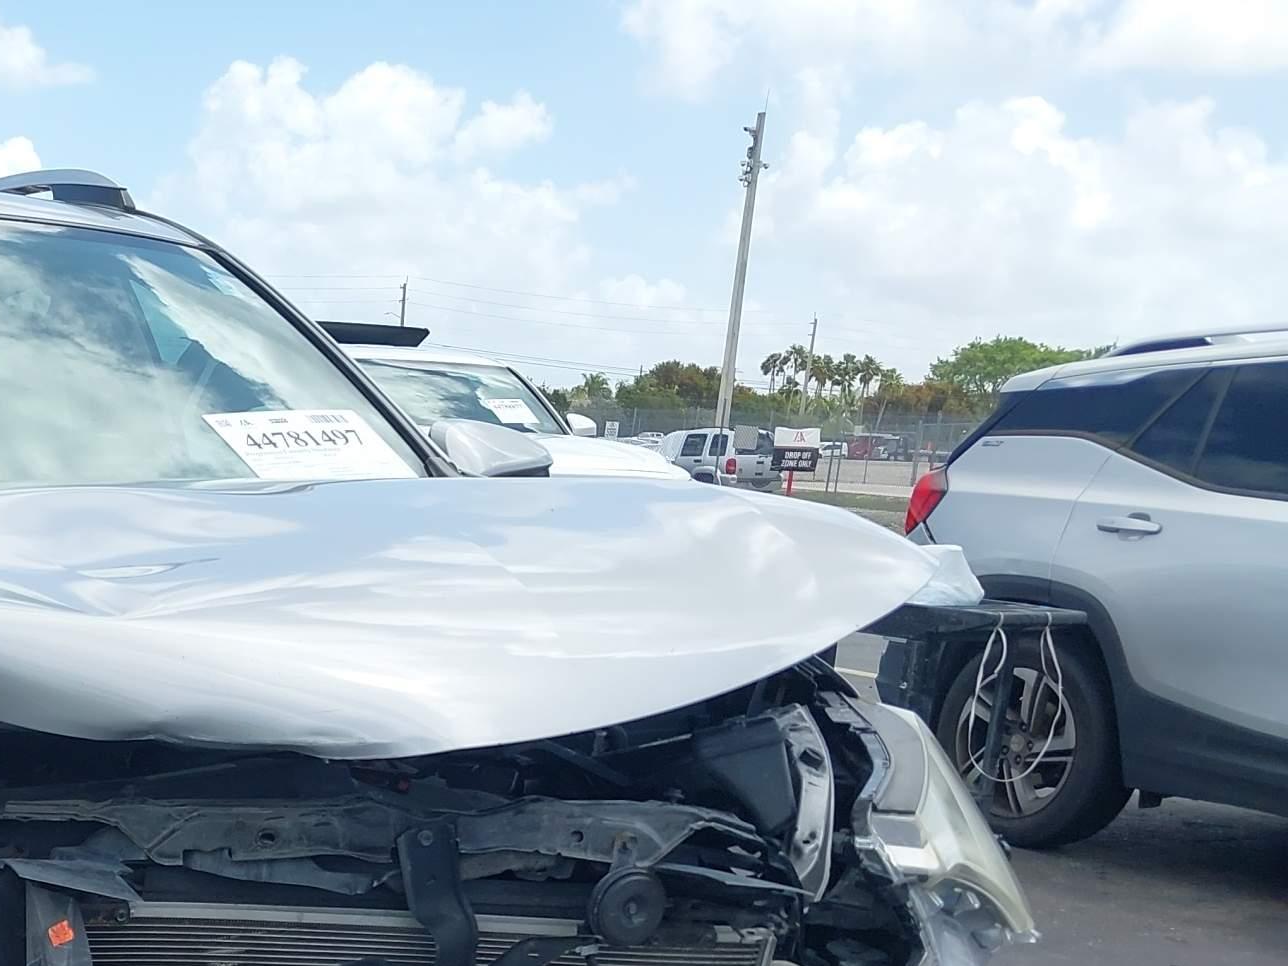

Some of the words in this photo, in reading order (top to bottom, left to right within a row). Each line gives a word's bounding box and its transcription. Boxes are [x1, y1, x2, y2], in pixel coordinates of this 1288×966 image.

[246, 429, 364, 449] 44781497
[784, 451, 801, 459] DROP
[781, 459, 798, 467] ZONE
[798, 460, 812, 468] ONLY
